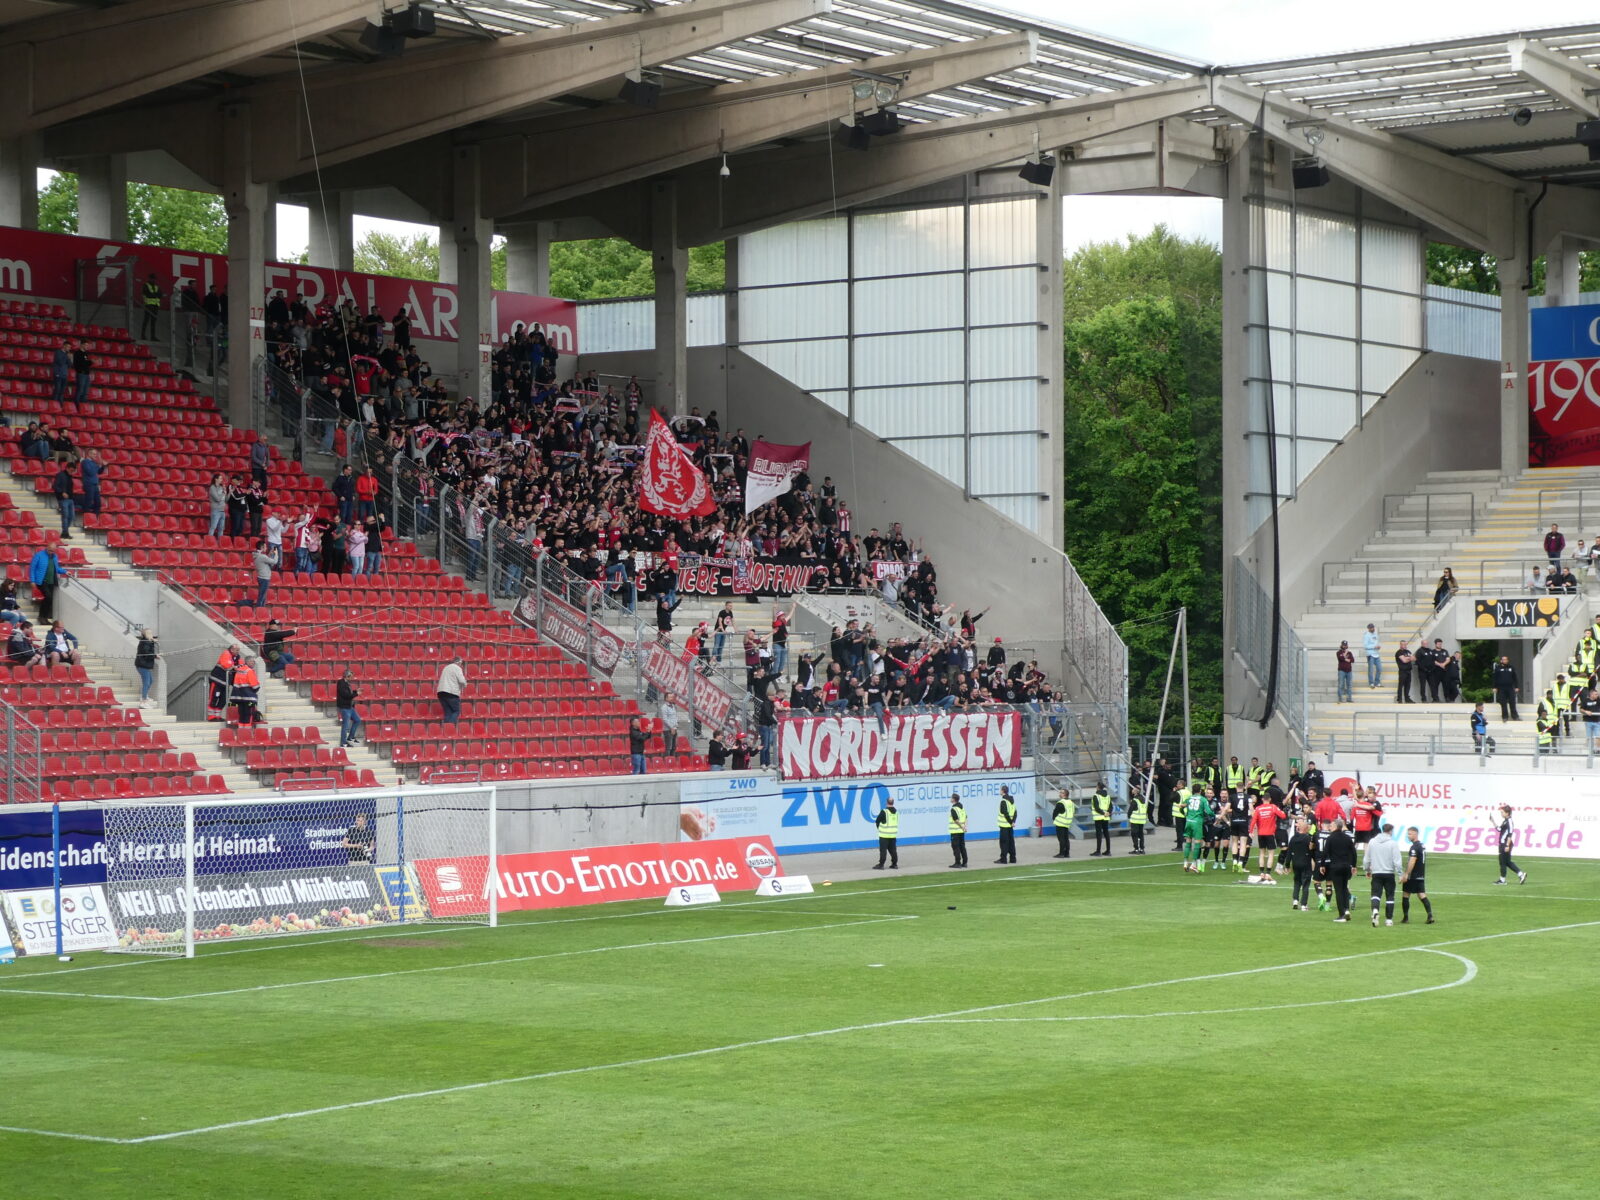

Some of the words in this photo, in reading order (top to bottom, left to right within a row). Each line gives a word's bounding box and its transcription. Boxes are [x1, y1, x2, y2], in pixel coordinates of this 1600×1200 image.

[251, 307, 264, 320] 17
[253, 327, 262, 340] A
[480, 333, 491, 345] 17
[481, 351, 489, 363] B
[781, 714, 1013, 777] NORDHESSEN
[730, 779, 757, 790] ZWO
[1374, 782, 1453, 799] ZUHAUSE
[897, 787, 915, 801] DIE
[962, 782, 984, 798] DER
[986, 782, 1026, 797] REION
[781, 782, 890, 828] ZWO
[304, 826, 348, 838] Stadtwerke
[120, 841, 164, 863] Herz
[210, 833, 281, 857] Heimat.
[309, 839, 344, 850] Offenbac
[749, 857, 774, 867] NISSAN
[117, 888, 157, 918] NEU
[155, 890, 176, 915] in
[261, 881, 294, 906] und
[292, 875, 371, 904] Mühlheim
[436, 893, 474, 904] SEAT
